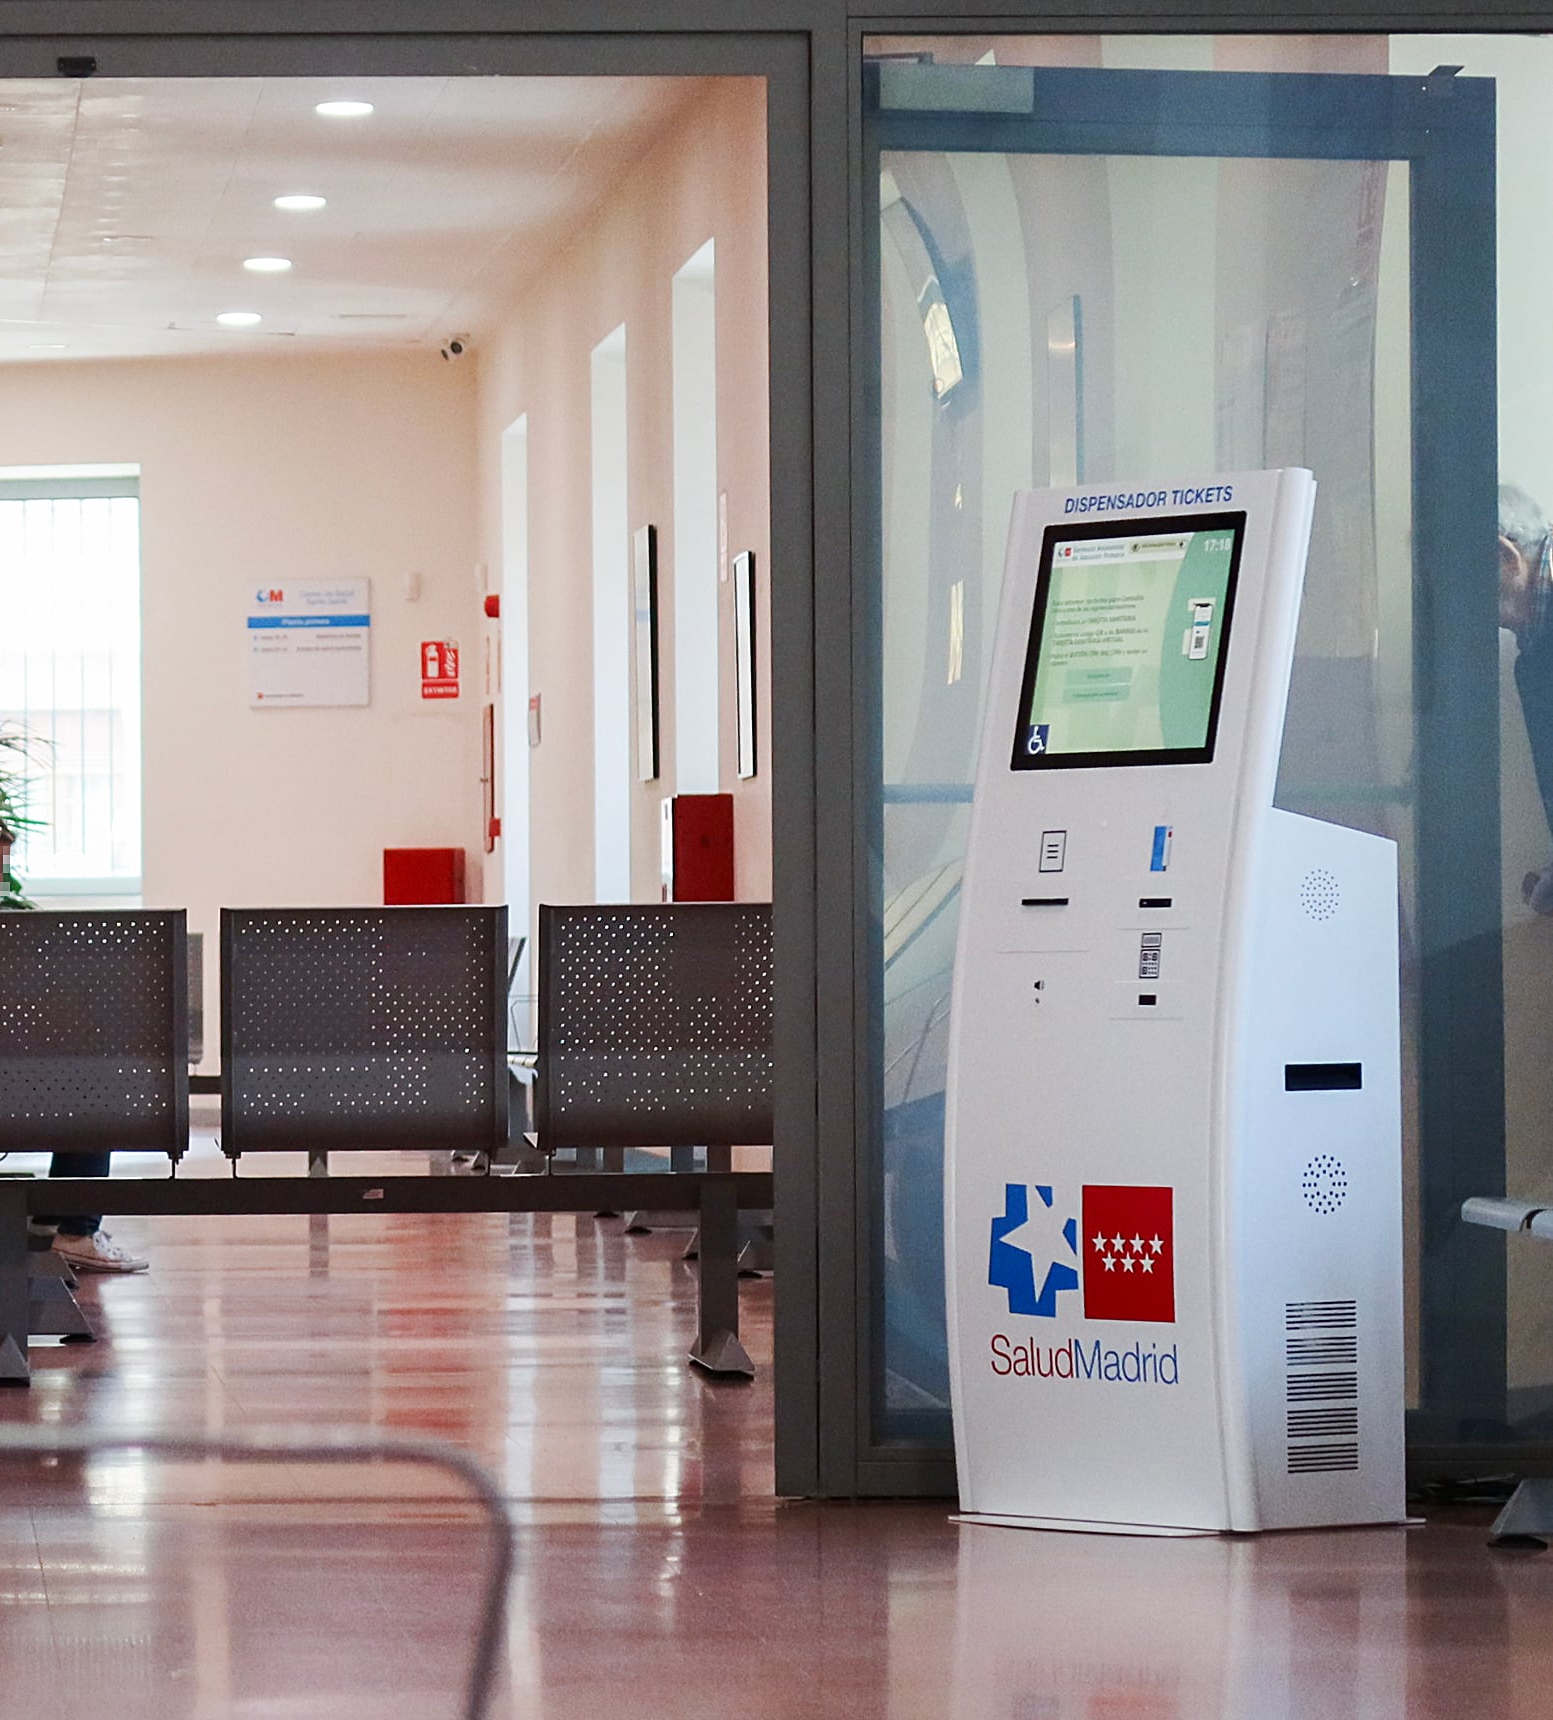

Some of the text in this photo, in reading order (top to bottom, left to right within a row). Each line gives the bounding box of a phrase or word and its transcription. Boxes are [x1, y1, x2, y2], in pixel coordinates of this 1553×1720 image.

[1064, 485, 1234, 514] DISPENSADOR TICKETS
[990, 1333, 1179, 1385] SaludMadrid
